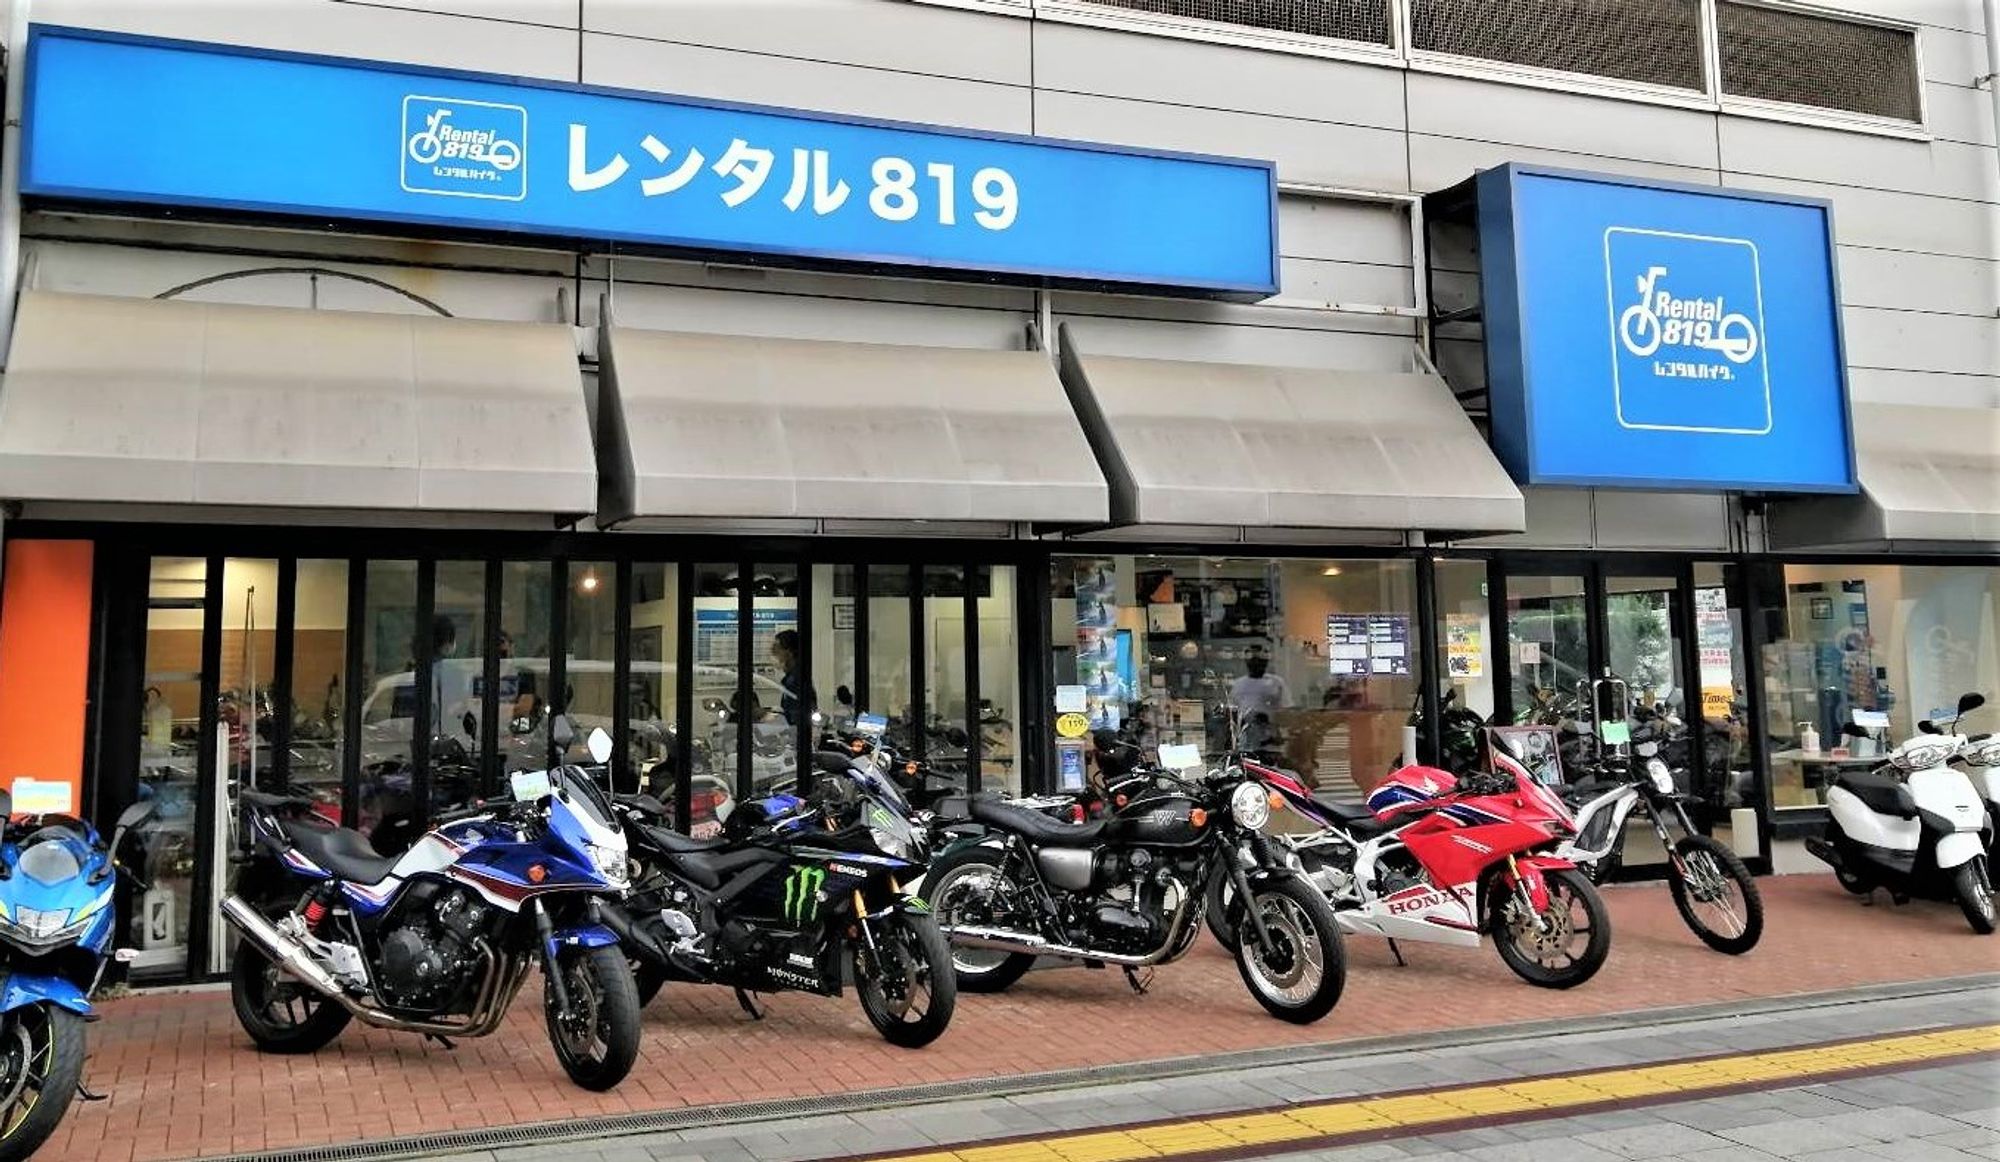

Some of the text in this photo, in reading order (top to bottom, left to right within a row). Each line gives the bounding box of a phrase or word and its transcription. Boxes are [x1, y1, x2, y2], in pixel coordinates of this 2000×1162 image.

[440, 124, 496, 145] Rental
[442, 141, 485, 160] 819
[1656, 291, 1723, 322] Rental
[1662, 319, 1713, 347] 819
[766, 966, 819, 989] MONSTER
